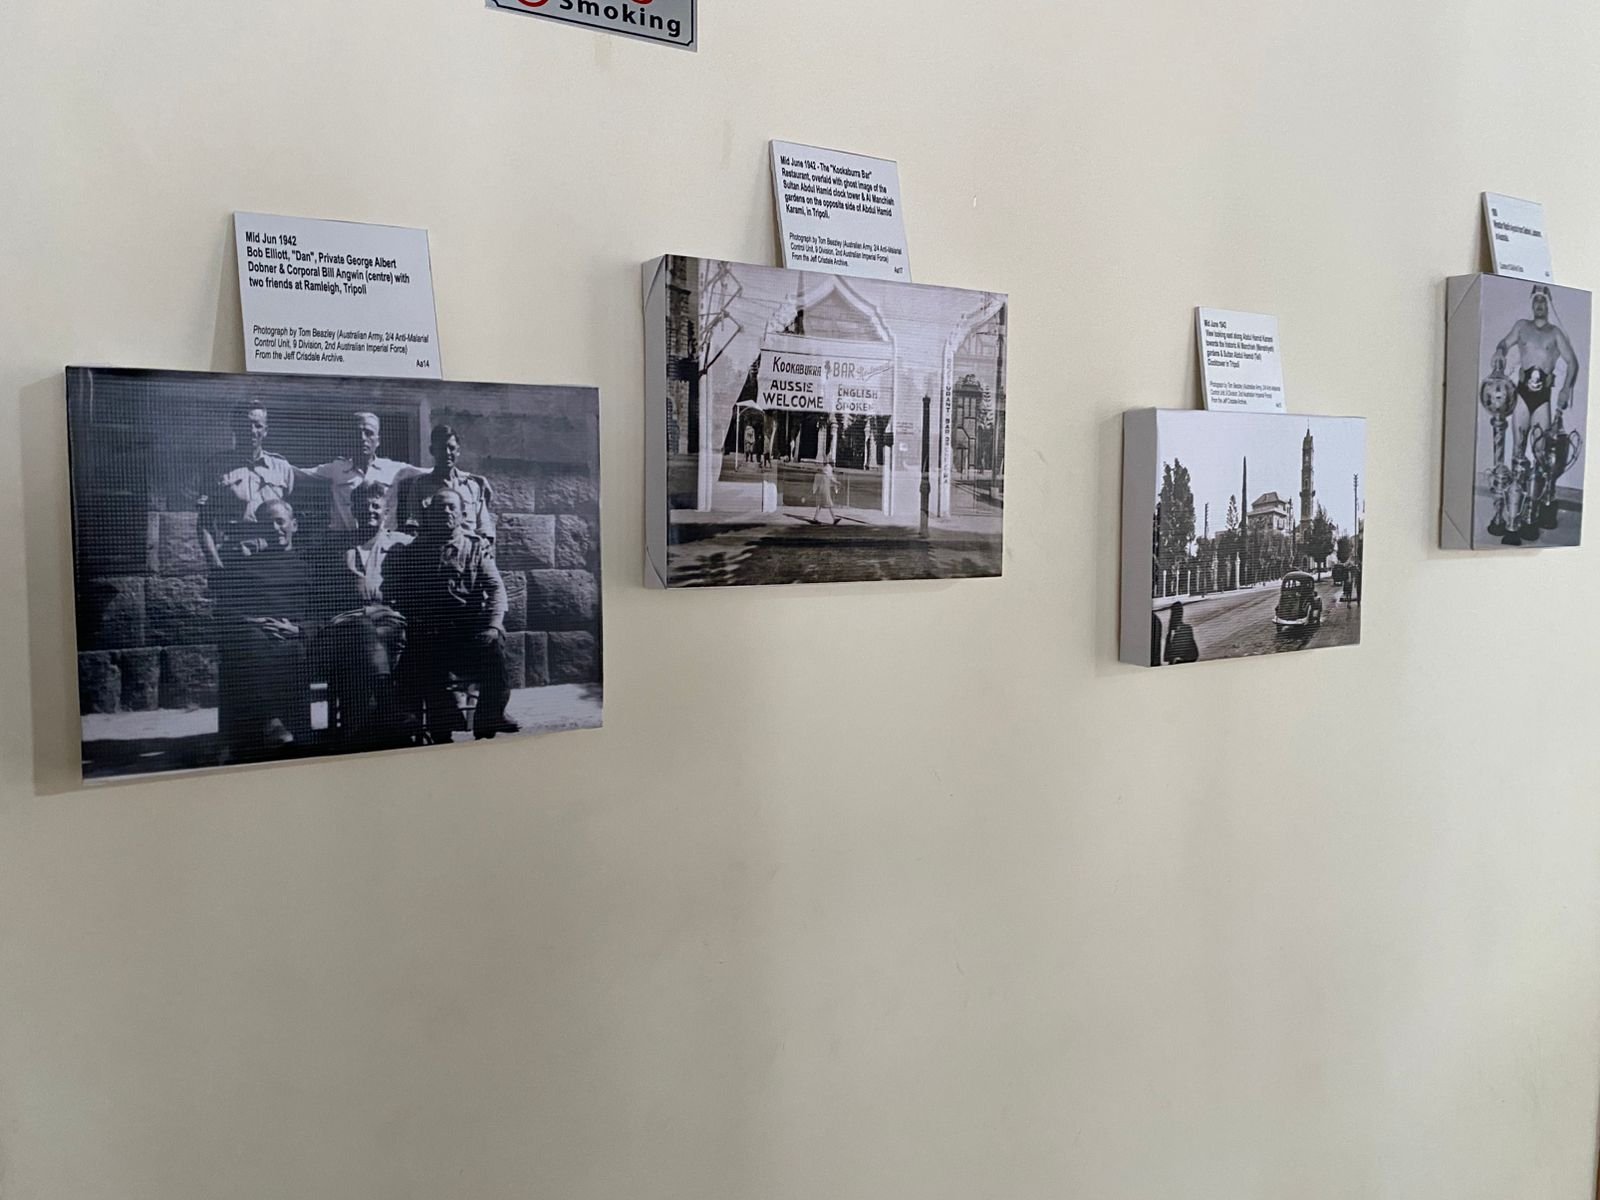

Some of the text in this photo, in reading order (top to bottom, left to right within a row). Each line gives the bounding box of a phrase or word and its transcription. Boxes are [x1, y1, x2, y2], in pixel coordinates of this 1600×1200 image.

[780, 156, 790, 165] Mid
[791, 158, 803, 168] June
[804, 160, 816, 170] 1942
[820, 162, 829, 172] The
[830, 164, 860, 178] "Kookaburra
[861, 170, 872, 179] Bar"
[782, 168, 810, 181] Restaurant,
[812, 174, 831, 184] overlaid
[832, 177, 843, 186] with
[844, 179, 857, 189] ghost
[858, 180, 872, 192] image
[874, 184, 878, 192] of
[783, 180, 799, 190] Sultan
[801, 183, 815, 193] Abdul
[816, 185, 832, 196] Hamid
[833, 188, 846, 198] clock
[847, 191, 860, 200] tower
[861, 192, 865, 201] &
[866, 193, 871, 202] Al
[785, 193, 805, 203] gardens
[814, 197, 822, 206] the
[823, 200, 844, 209] opposite
[845, 201, 855, 211] side
[856, 203, 861, 212] of
[862, 203, 876, 214] Abdul
[877, 206, 892, 216] Hamid
[806, 207, 812, 216] in
[812, 208, 830, 219] Tripoli.
[246, 232, 297, 246] Mid Jun 1942
[789, 232, 811, 243] Photograph
[812, 236, 817, 245] by
[827, 237, 842, 248] Beazley
[843, 240, 862, 249] (Australian
[247, 246, 263, 258] Bob
[265, 248, 290, 261] Elliott,
[318, 252, 345, 264] Private
[346, 254, 373, 269] George
[375, 257, 396, 269] Albert
[792, 252, 802, 260] From
[248, 261, 410, 284] Dobner & Corporal Bill Angwin (centre) with
[249, 277, 367, 296] two friends at Ramleigh, Tripoli
[253, 325, 288, 337] Photograph
[290, 328, 297, 338] by
[298, 327, 311, 337] Tom
[312, 328, 336, 340] Beazley
[337, 330, 367, 340] (Australian
[385, 332, 394, 341] 2/4
[395, 333, 429, 343] Anti-Malarial
[254, 337, 408, 355] Control Unit, 9 Division, 2nd Australian Imperial Force)
[255, 350, 344, 362] From the Jeff Crisdale Archive.
[416, 360, 429, 368] Aa14
[833, 362, 855, 378] BAR
[770, 380, 813, 393] AUSSIE
[838, 384, 877, 399] ENGLISH
[763, 393, 823, 408] WELCOME
